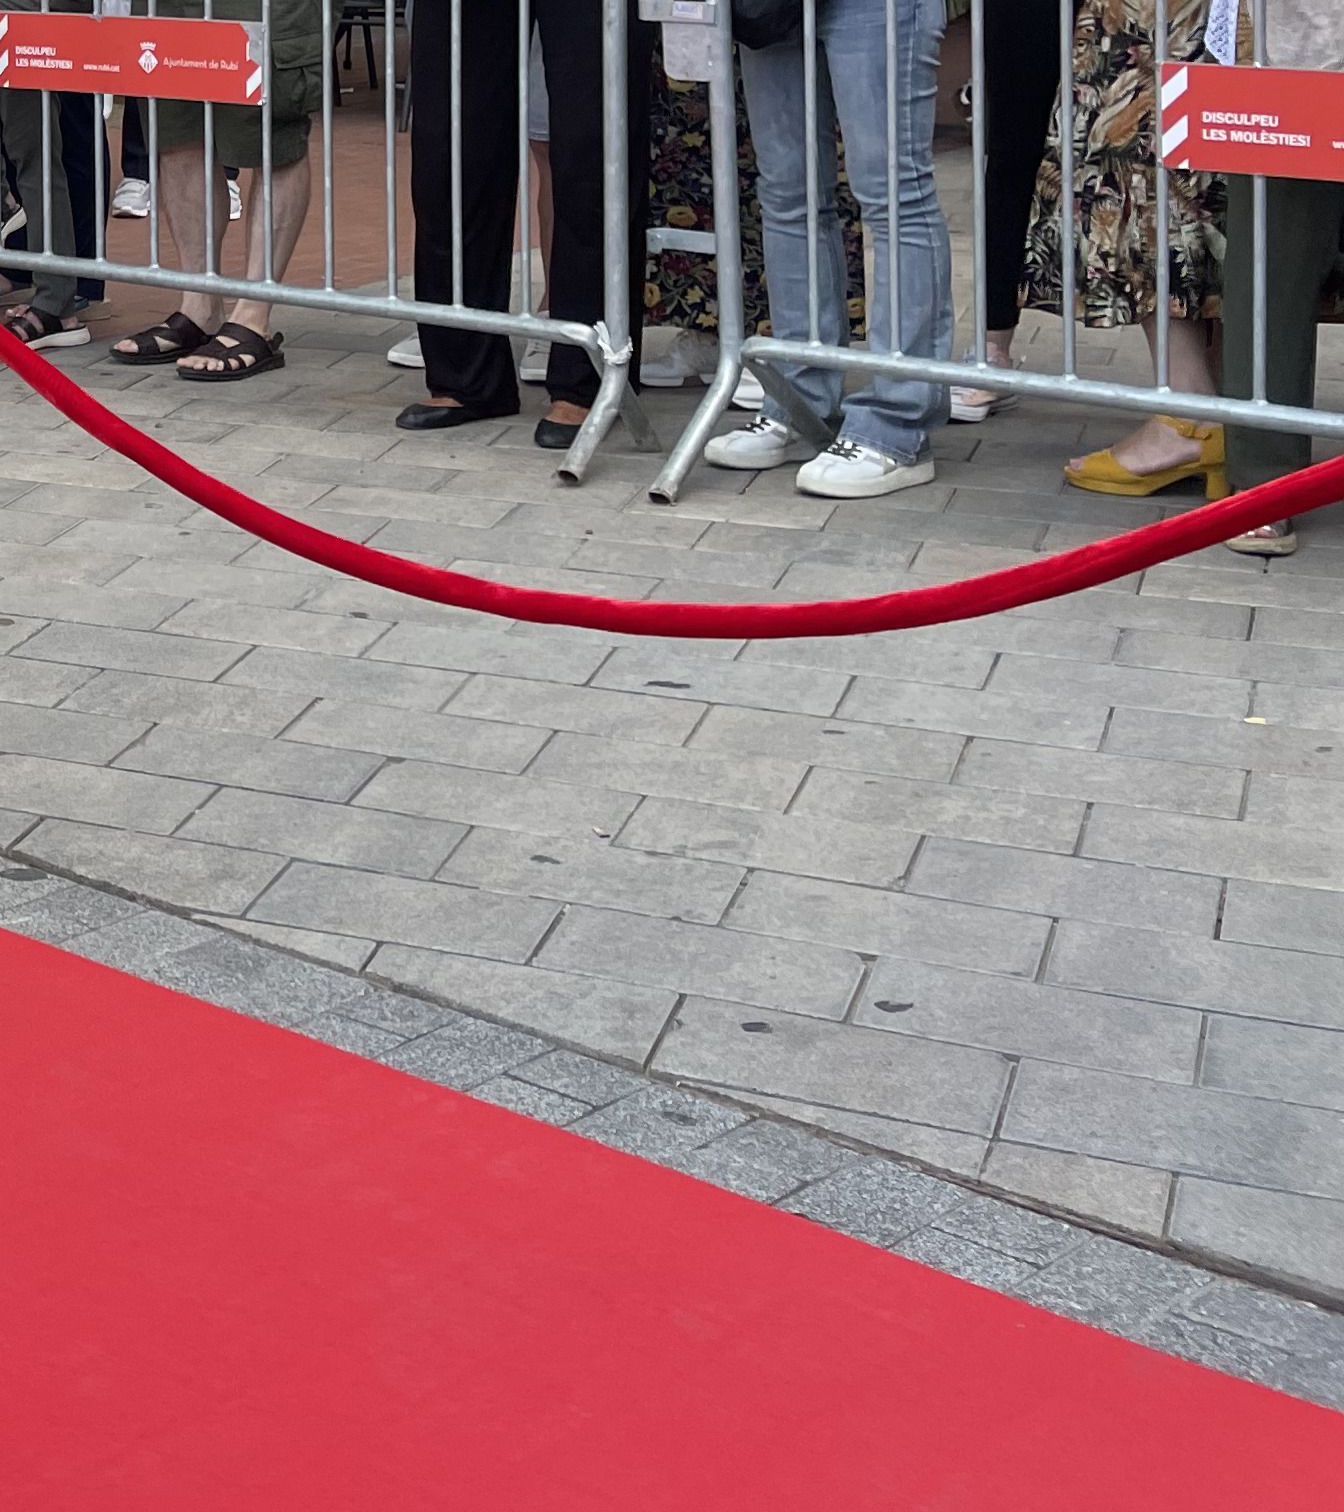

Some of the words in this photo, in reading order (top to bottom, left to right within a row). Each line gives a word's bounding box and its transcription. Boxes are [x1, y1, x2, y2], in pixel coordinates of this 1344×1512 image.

[15, 45, 56, 56] DISCULPEU
[15, 57, 29, 68] LES
[162, 56, 208, 69] Ajuntament
[208, 59, 219, 70] de
[1201, 111, 1279, 128] DISCULPEU
[1201, 128, 1228, 141] LES
[1230, 129, 1311, 148] MOLÈSTIES!
